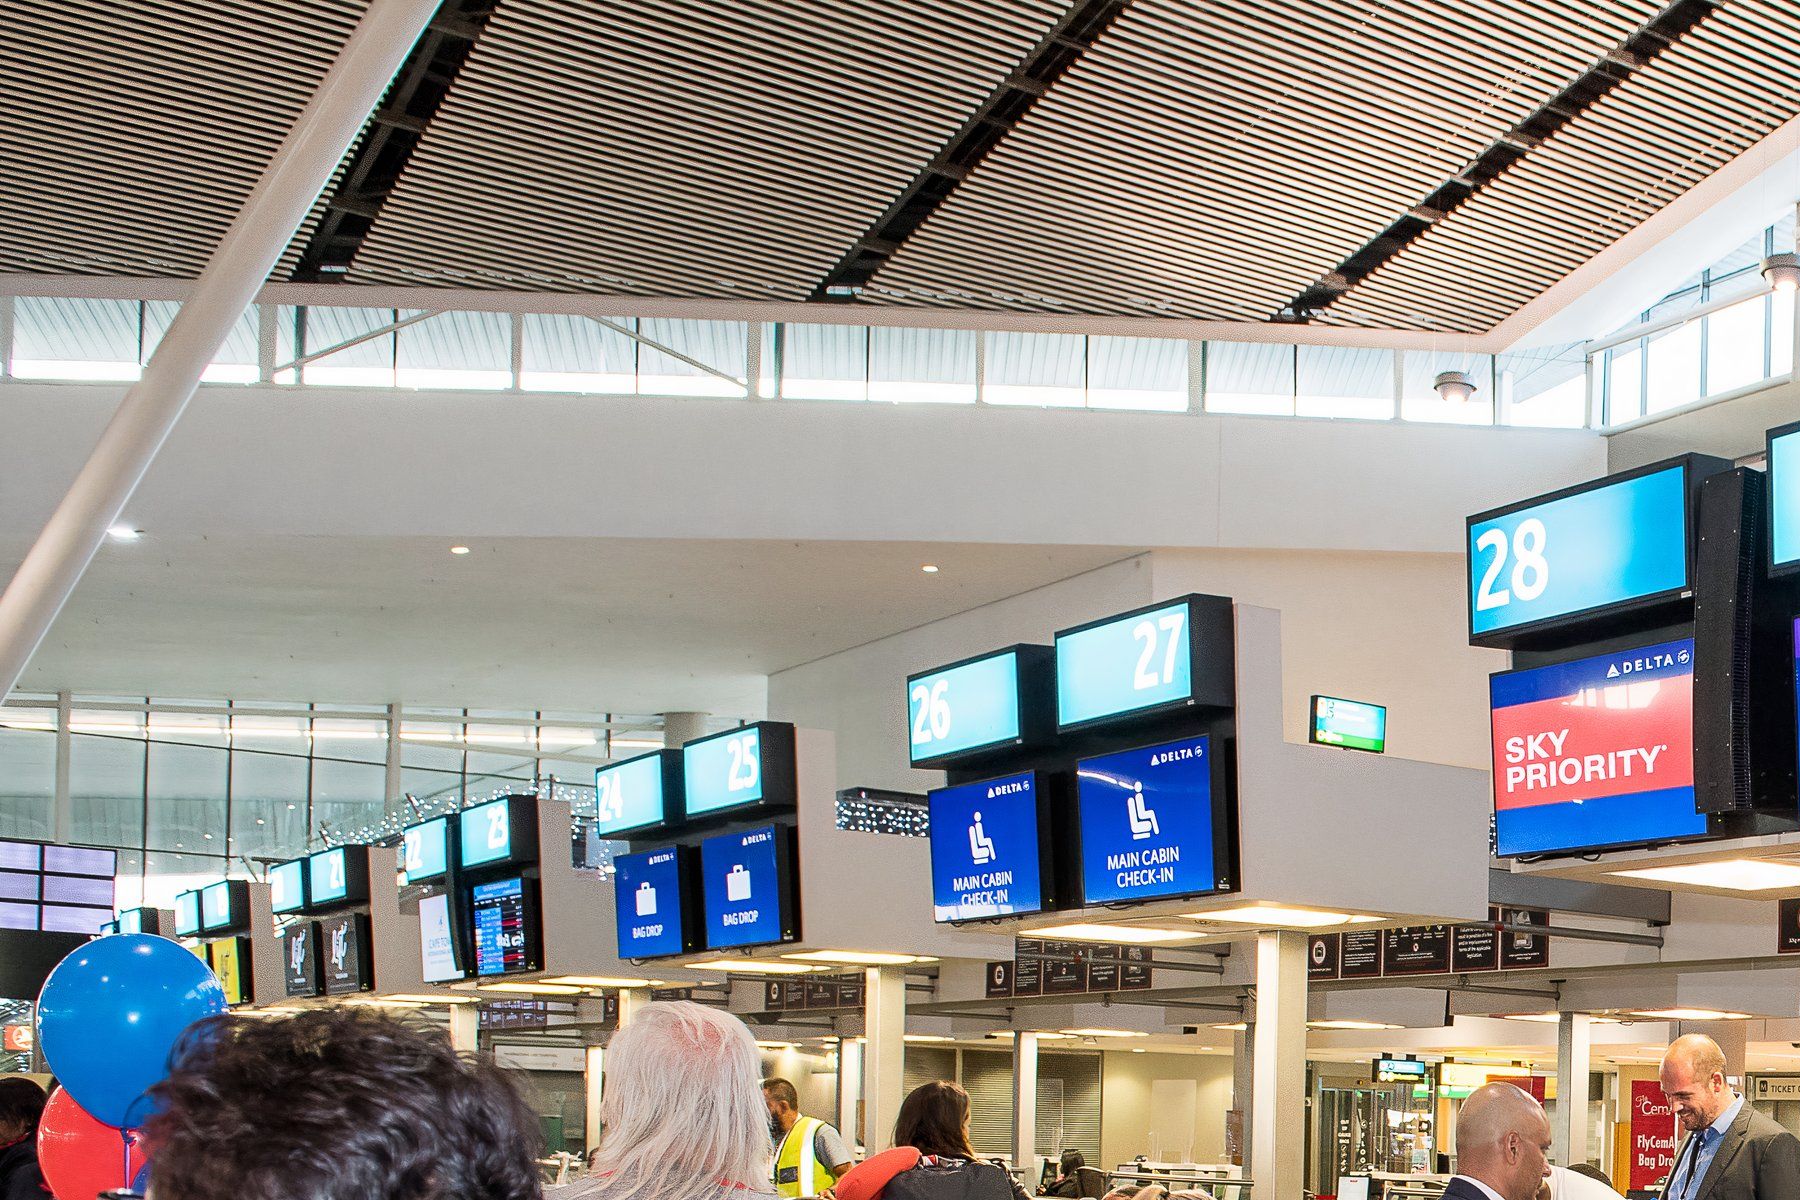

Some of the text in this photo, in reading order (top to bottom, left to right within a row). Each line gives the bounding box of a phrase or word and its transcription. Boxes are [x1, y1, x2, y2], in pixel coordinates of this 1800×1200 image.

[1476, 519, 1549, 611] 28
[1132, 611, 1186, 690] 27
[1622, 653, 1675, 676] DELTA
[911, 680, 950, 744] 26
[1160, 746, 1193, 764] DELTA
[1505, 729, 1569, 763] SKY
[726, 734, 759, 792] 25
[1505, 745, 1668, 792] PRIORITY
[597, 771, 623, 823] 24
[996, 781, 1023, 798] DELTA
[487, 804, 508, 849] 23
[747, 833, 767, 845] DELTA
[653, 854, 670, 865] DELTA
[1107, 846, 1180, 871] MAIN CABIN
[953, 871, 1012, 893] MAIN CABIN
[1116, 866, 1174, 887] CHECK-IN
[961, 890, 1009, 908] CHECK-IN
[722, 910, 758, 927] BAG DROP
[632, 924, 663, 939] BAG DROP
[1771, 1085, 1795, 1093] TICKET
[1638, 1153, 1656, 1170] Bag
